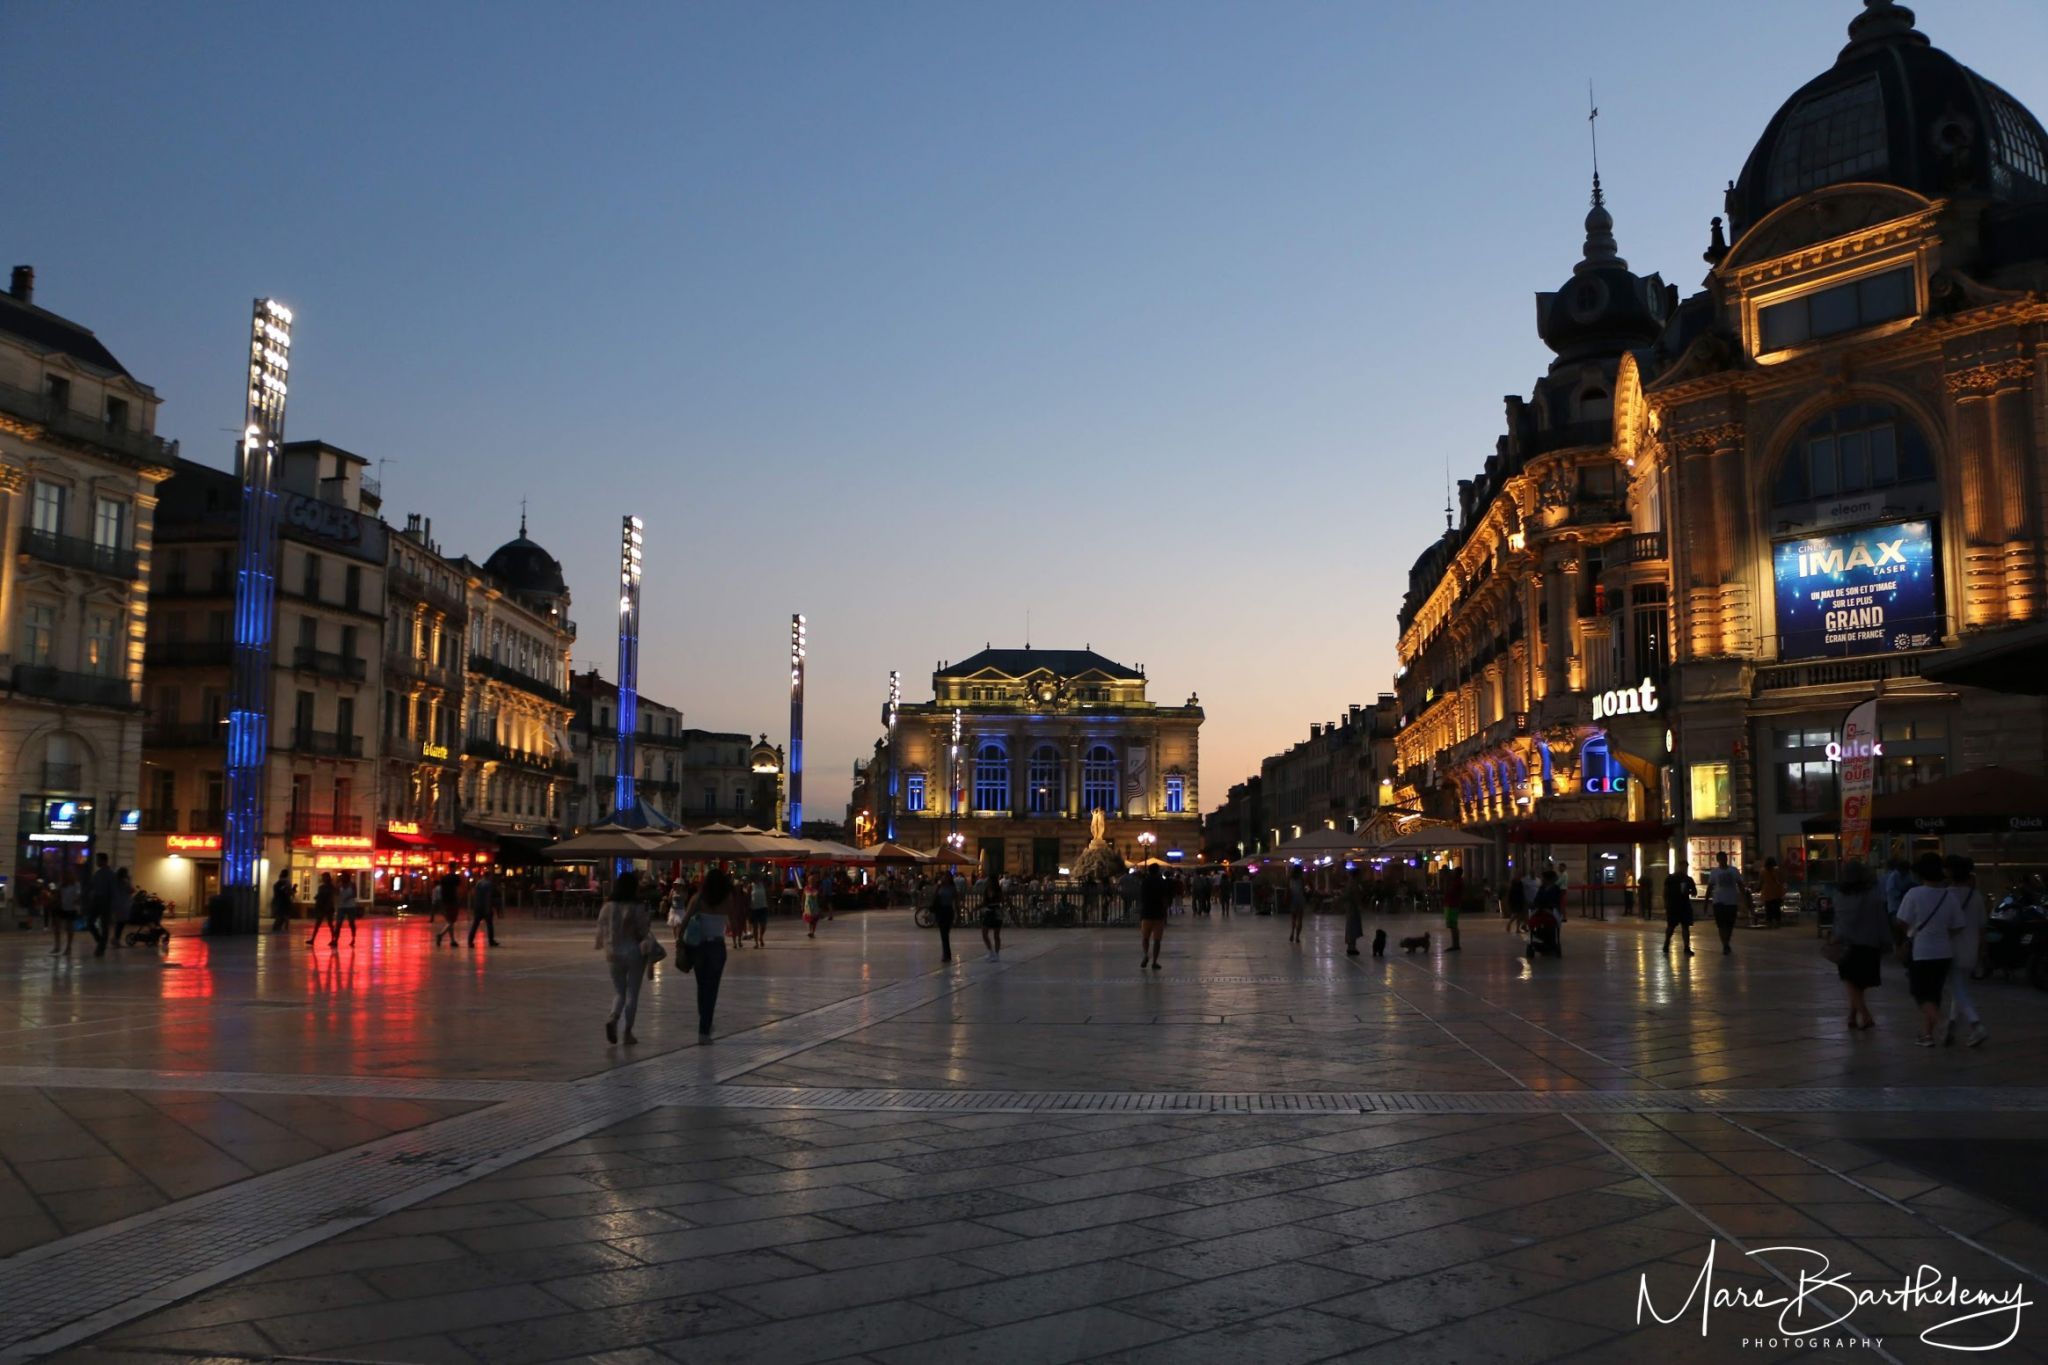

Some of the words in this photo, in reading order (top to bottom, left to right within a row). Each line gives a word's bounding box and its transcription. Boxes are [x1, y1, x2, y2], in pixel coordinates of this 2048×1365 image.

[1798, 539, 1907, 578] IMAX
[1873, 564, 1906, 576] LASER
[1811, 592, 1820, 600] UN
[1821, 591, 1835, 599] MAX
[1836, 589, 1845, 597] DE
[1845, 587, 1859, 596] SON
[1860, 586, 1869, 594] ET
[1869, 581, 1897, 592] D'IMAGE
[1832, 599, 1846, 608] SUR
[1847, 598, 1855, 606] LE
[1856, 596, 1873, 605] PLUS
[1825, 606, 1884, 632] GRAND
[1825, 633, 1847, 643] ÉCRAN
[1847, 632, 1856, 641] DE
[1825, 740, 1883, 761] Quick
[1914, 816, 1945, 829] Quick
[2009, 816, 2043, 829] Quick
